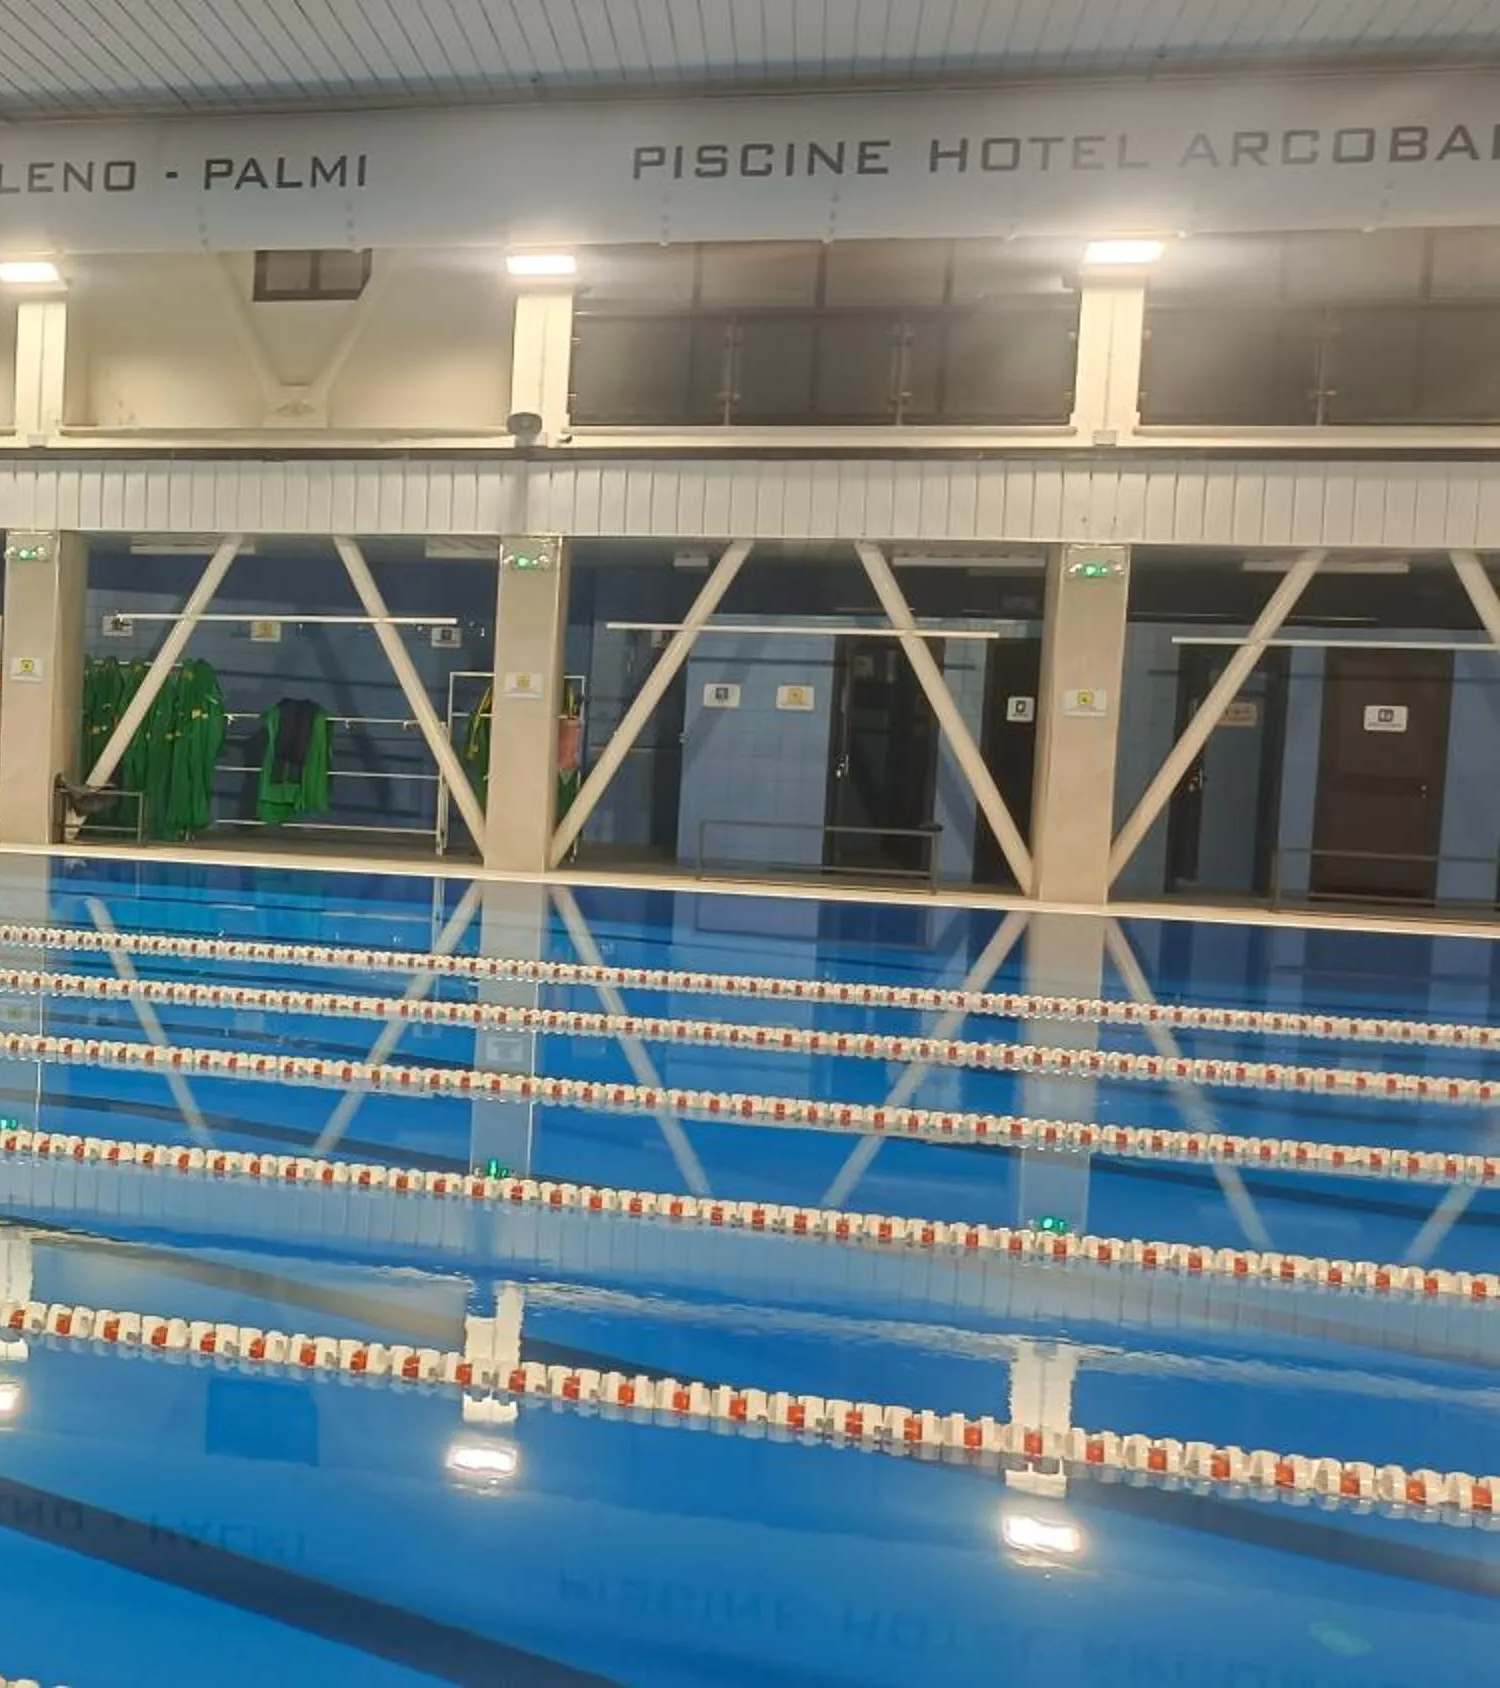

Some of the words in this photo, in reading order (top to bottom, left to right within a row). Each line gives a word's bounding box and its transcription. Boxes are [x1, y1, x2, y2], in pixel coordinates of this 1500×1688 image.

[203, 154, 368, 190] PALMI
[632, 139, 891, 180] PISCINE
[929, 134, 1149, 173] HOTEL
[1177, 122, 1500, 169] ARCOBA
